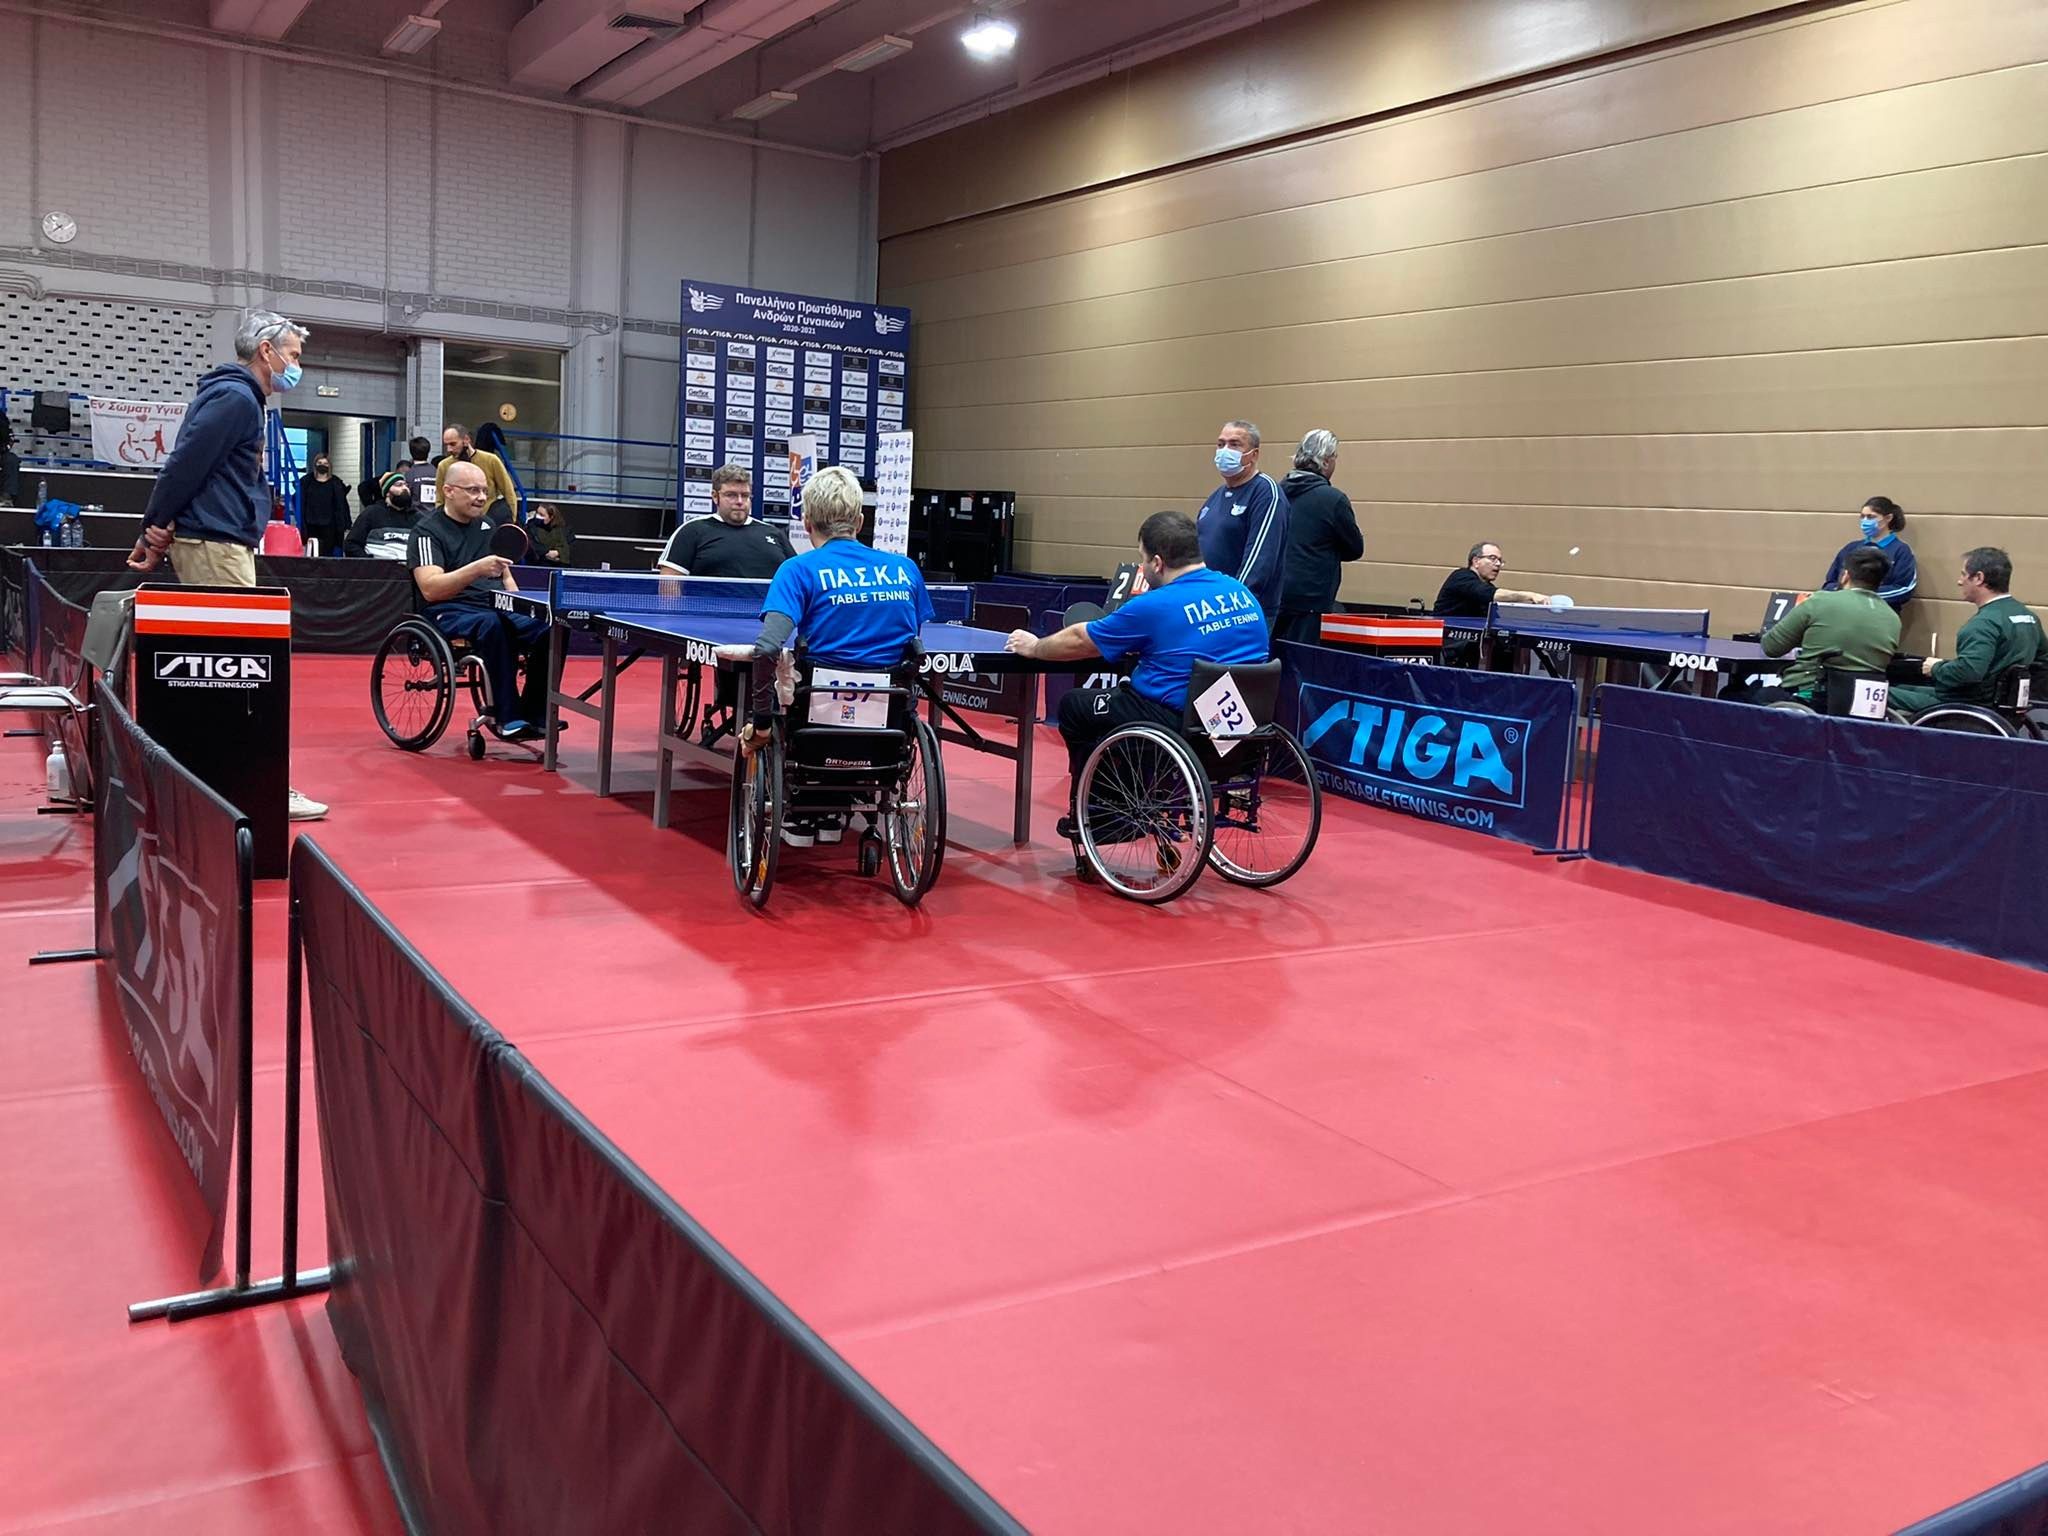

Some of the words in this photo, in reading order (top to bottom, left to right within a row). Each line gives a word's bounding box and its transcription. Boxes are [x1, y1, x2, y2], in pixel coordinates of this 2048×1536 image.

[735, 292, 796, 312] Πανελλήνιο
[797, 300, 862, 320] Πρωτάθλημα
[753, 308, 795, 324] Ανδρών
[796, 314, 845, 329] Γυναικών
[782, 324, 816, 335] 2020-2021
[108, 402, 152, 414] Σώματι
[1112, 572, 1130, 599] 2
[829, 593, 868, 606] TABLE
[870, 590, 910, 602] TENNIS
[1774, 599, 1788, 621] 7
[1198, 618, 1232, 636] TABLE
[1233, 612, 1260, 626] TENNIS
[685, 640, 718, 667] JOOLA
[919, 653, 974, 673] OOLA
[1668, 652, 1718, 672] JOOLA
[168, 680, 259, 689] STIGATABLETENNIS.COM
[1865, 687, 1886, 702] 163
[1216, 690, 1244, 731] 132
[1316, 770, 1494, 829] STIGATABLETENNIS.COM
